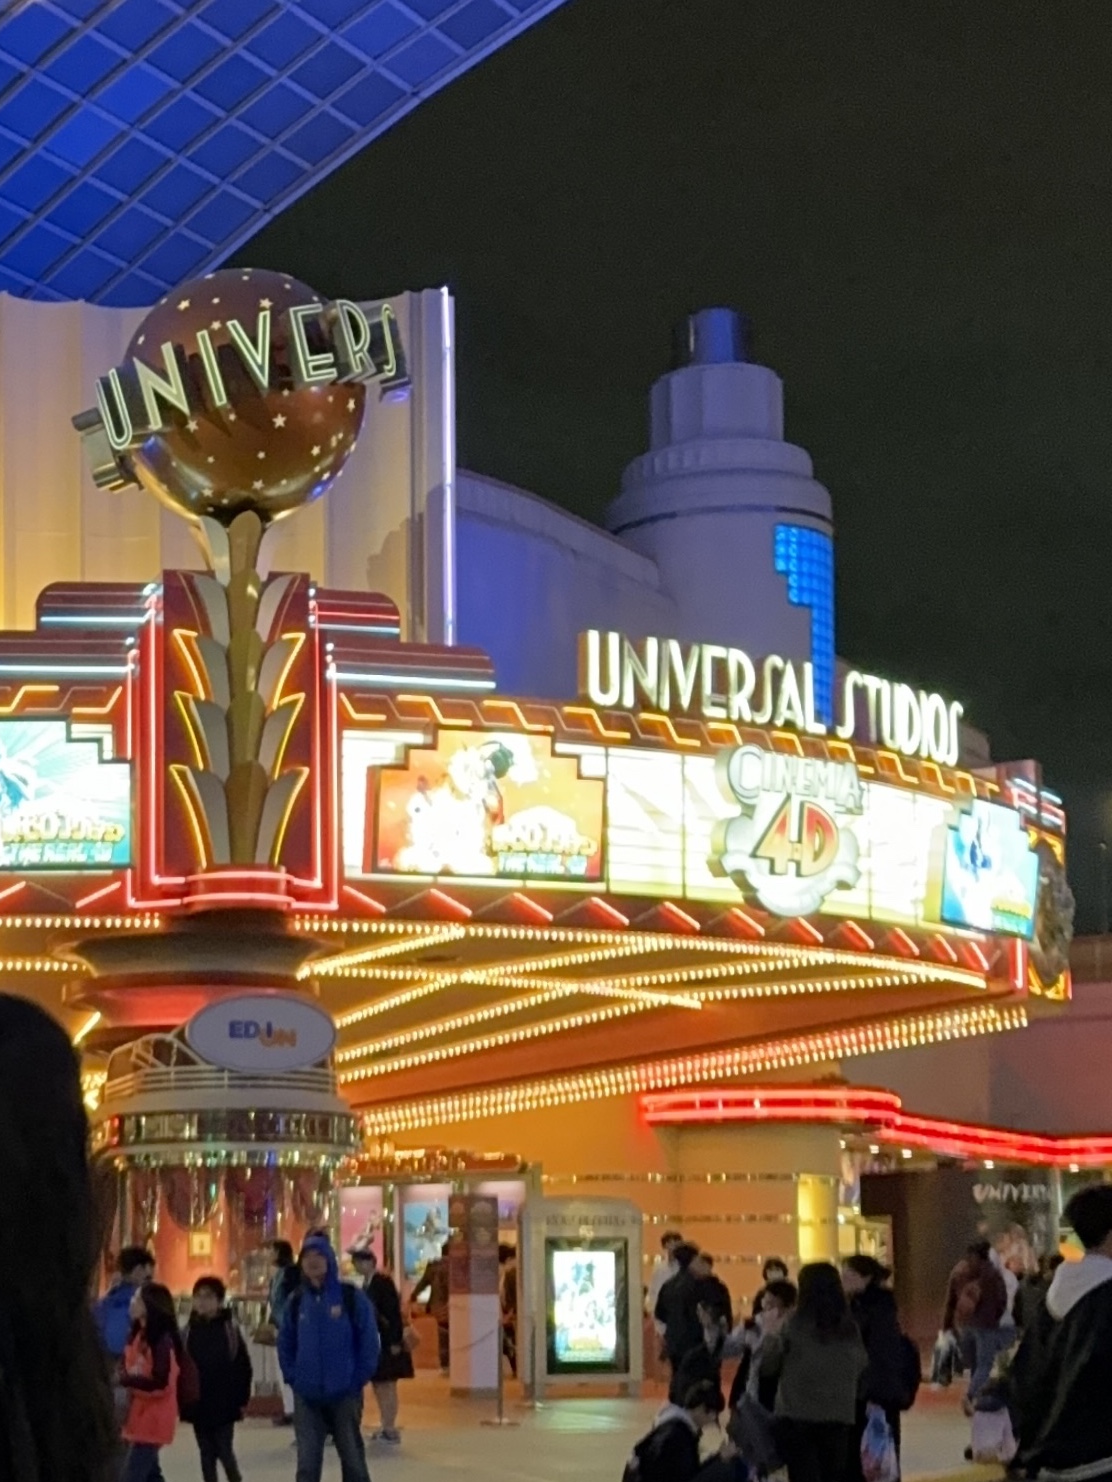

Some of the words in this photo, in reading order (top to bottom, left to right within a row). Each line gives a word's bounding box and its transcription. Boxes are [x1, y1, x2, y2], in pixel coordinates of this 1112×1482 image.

[586, 628, 827, 736] UNIVERSAL
[836, 669, 964, 767] STUDIOS
[727, 744, 865, 816] CINEMA
